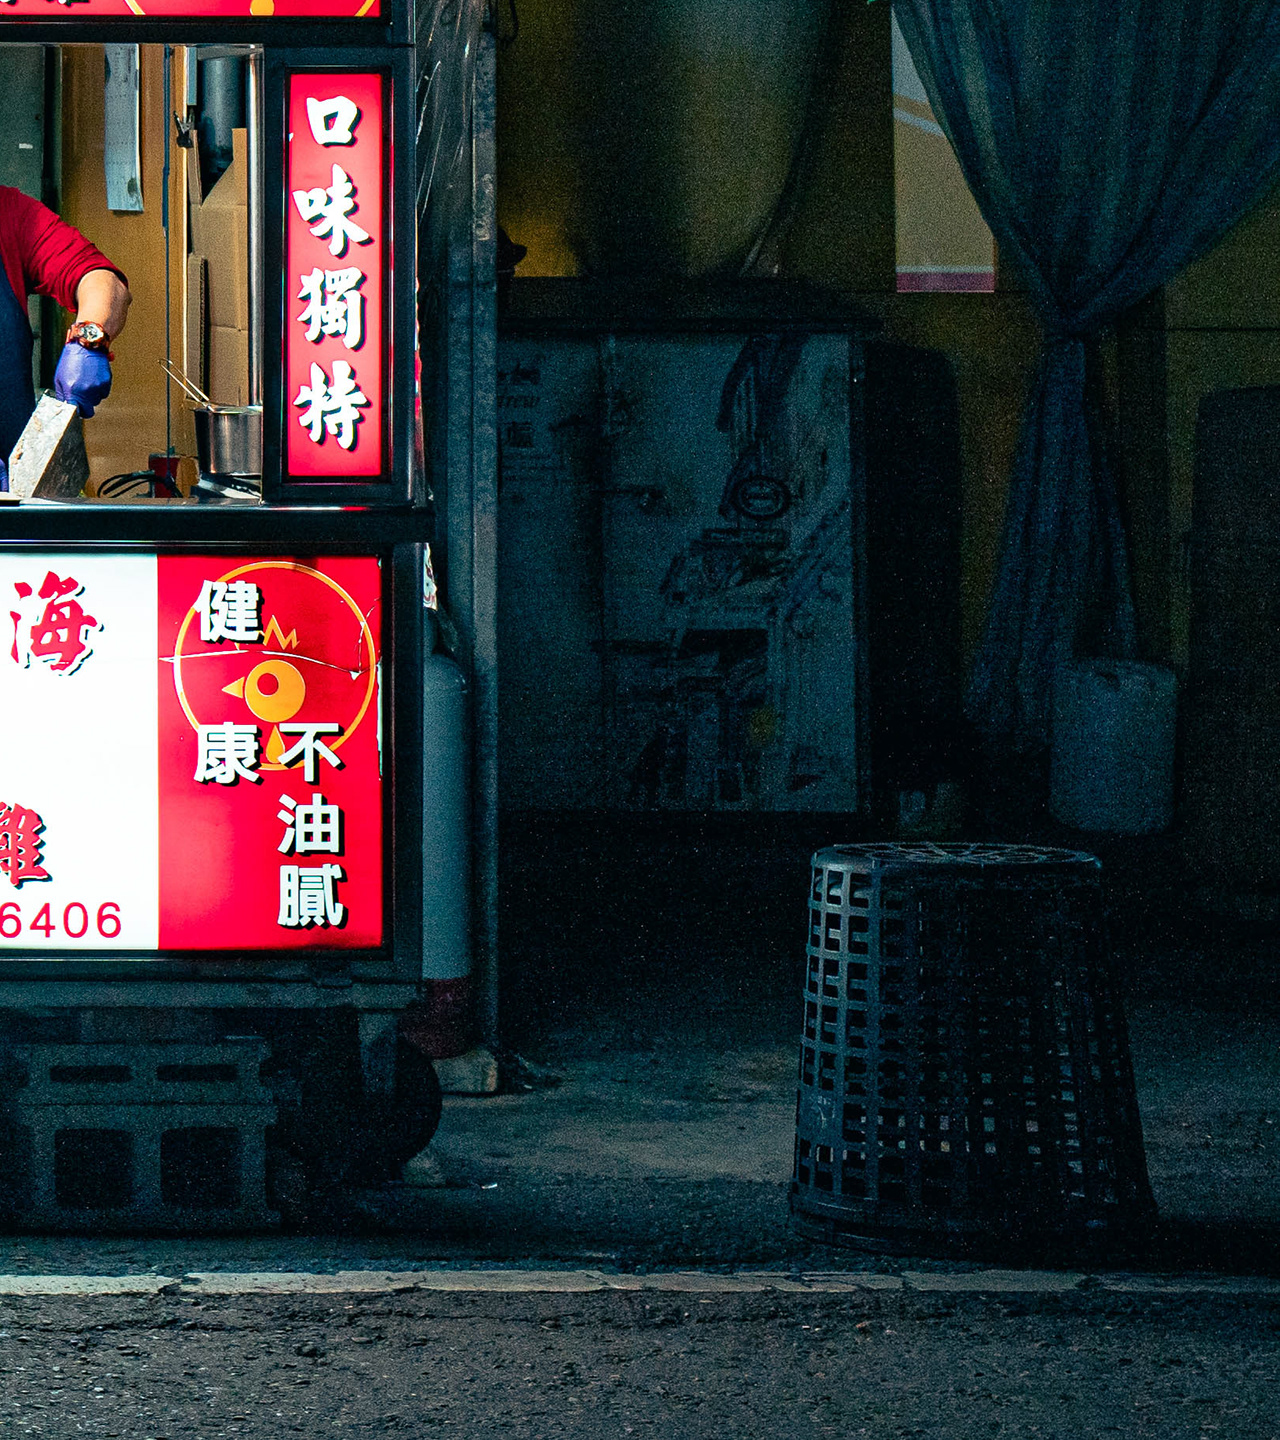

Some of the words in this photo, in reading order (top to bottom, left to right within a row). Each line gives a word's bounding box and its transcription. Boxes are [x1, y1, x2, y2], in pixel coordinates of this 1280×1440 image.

[292, 94, 375, 451] 口味獨特
[193, 578, 265, 786] 健康
[276, 720, 348, 932] 不油膩
